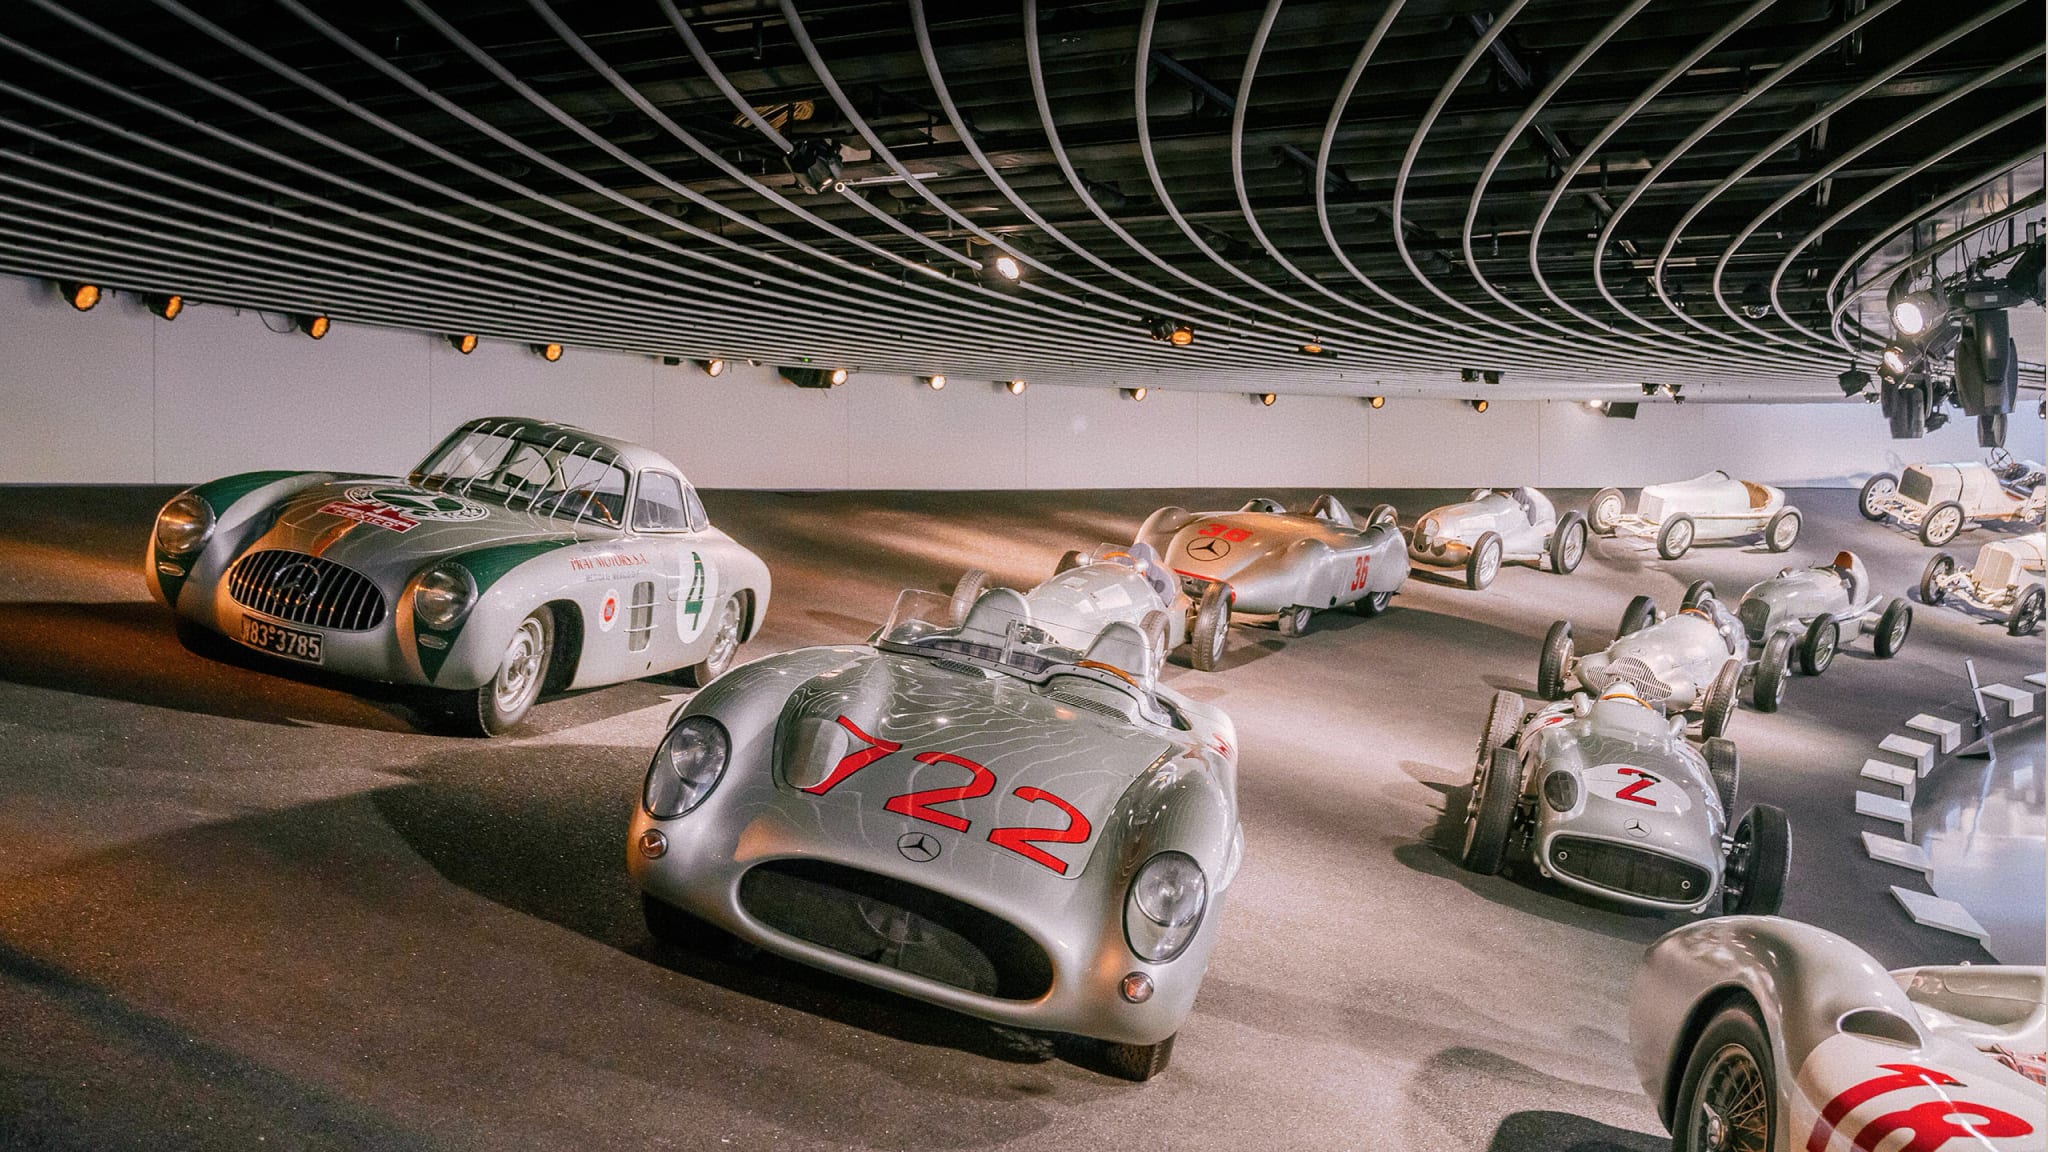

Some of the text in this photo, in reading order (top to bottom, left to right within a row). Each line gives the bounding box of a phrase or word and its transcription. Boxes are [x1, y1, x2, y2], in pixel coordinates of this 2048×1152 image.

[684, 551, 705, 631] 4
[1351, 555, 1370, 591] 36
[801, 715, 1092, 875] 722
[1616, 768, 1661, 807] 2
